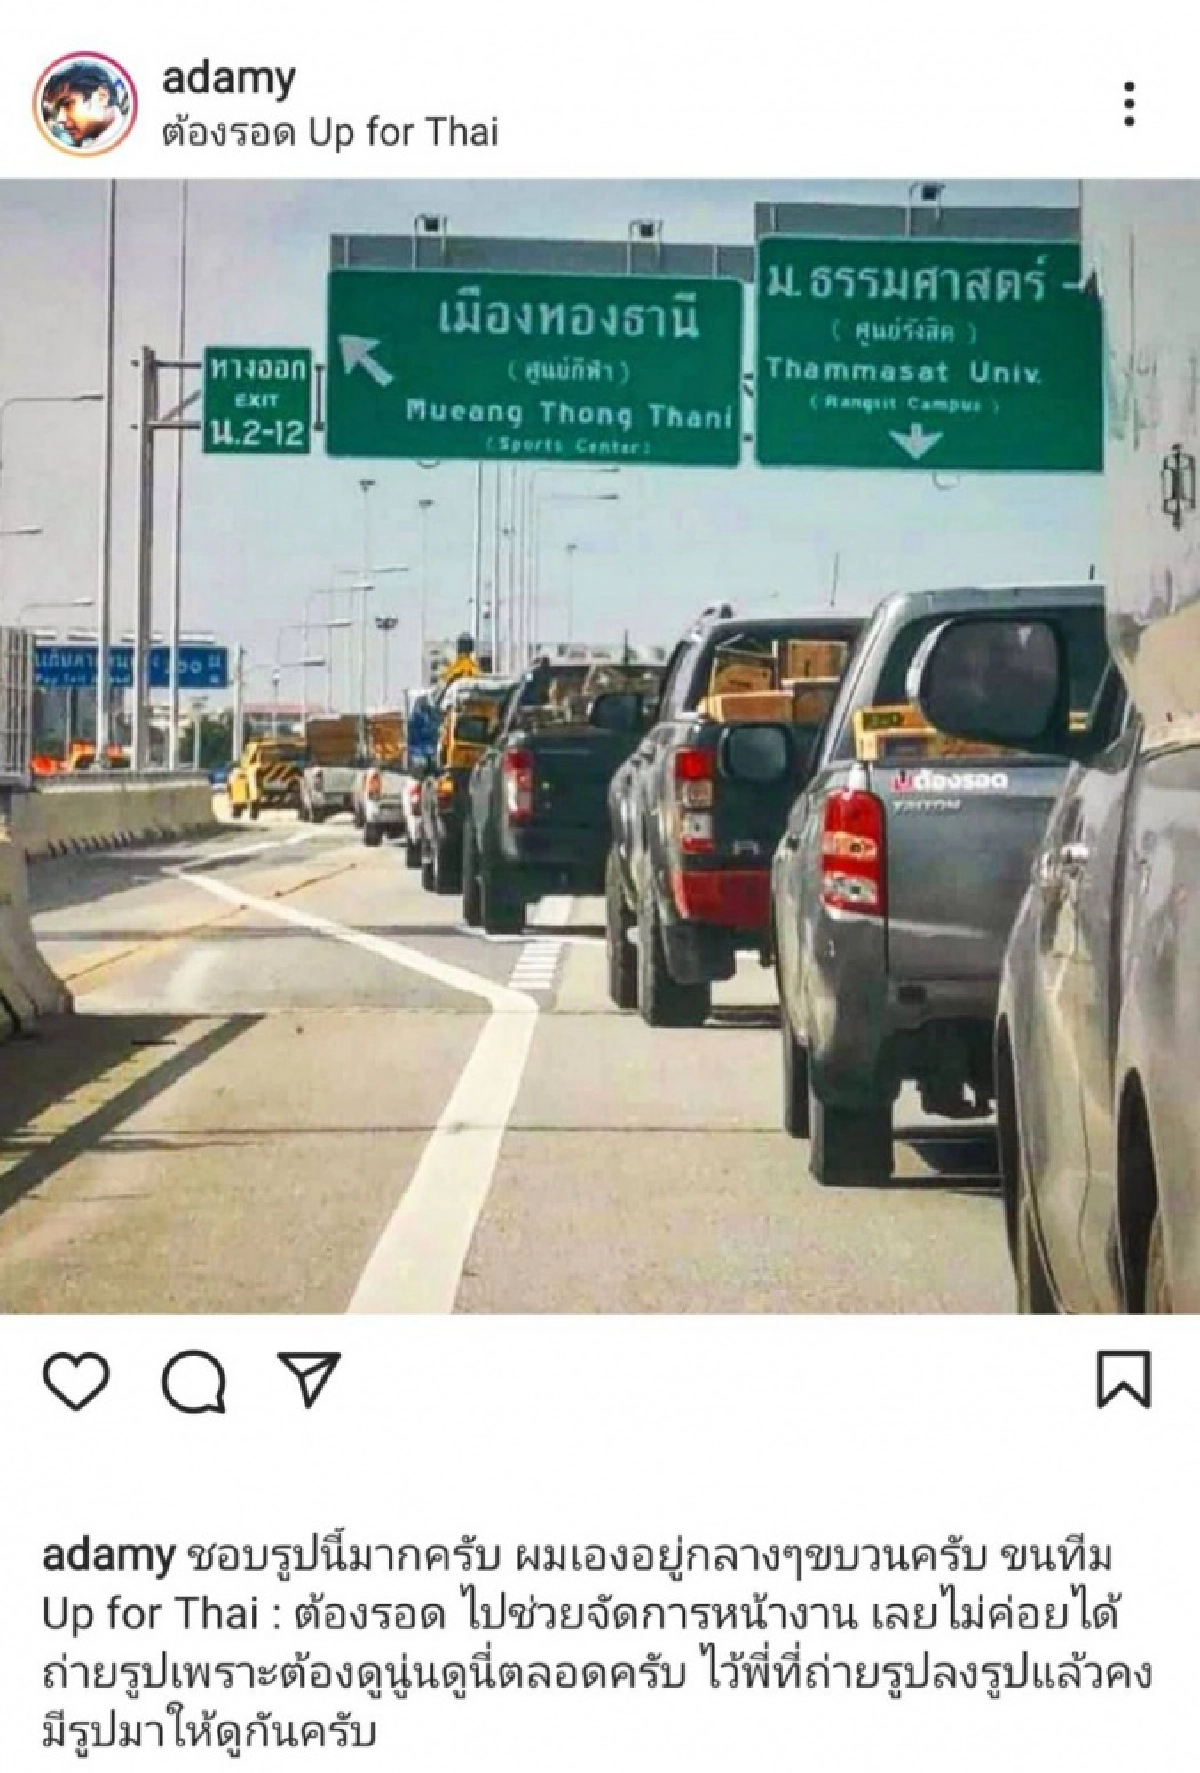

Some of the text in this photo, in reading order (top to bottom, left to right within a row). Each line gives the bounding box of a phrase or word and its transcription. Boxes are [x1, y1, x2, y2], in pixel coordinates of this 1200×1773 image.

[438, 287, 700, 340] เมืองทองธานี
[210, 356, 306, 381] ทางออก
[765, 356, 1044, 386] Thammasat Univ.
[234, 392, 280, 409] EXIT
[406, 397, 733, 433] Mueang Thong Thani
[209, 416, 306, 446] น.2-12
